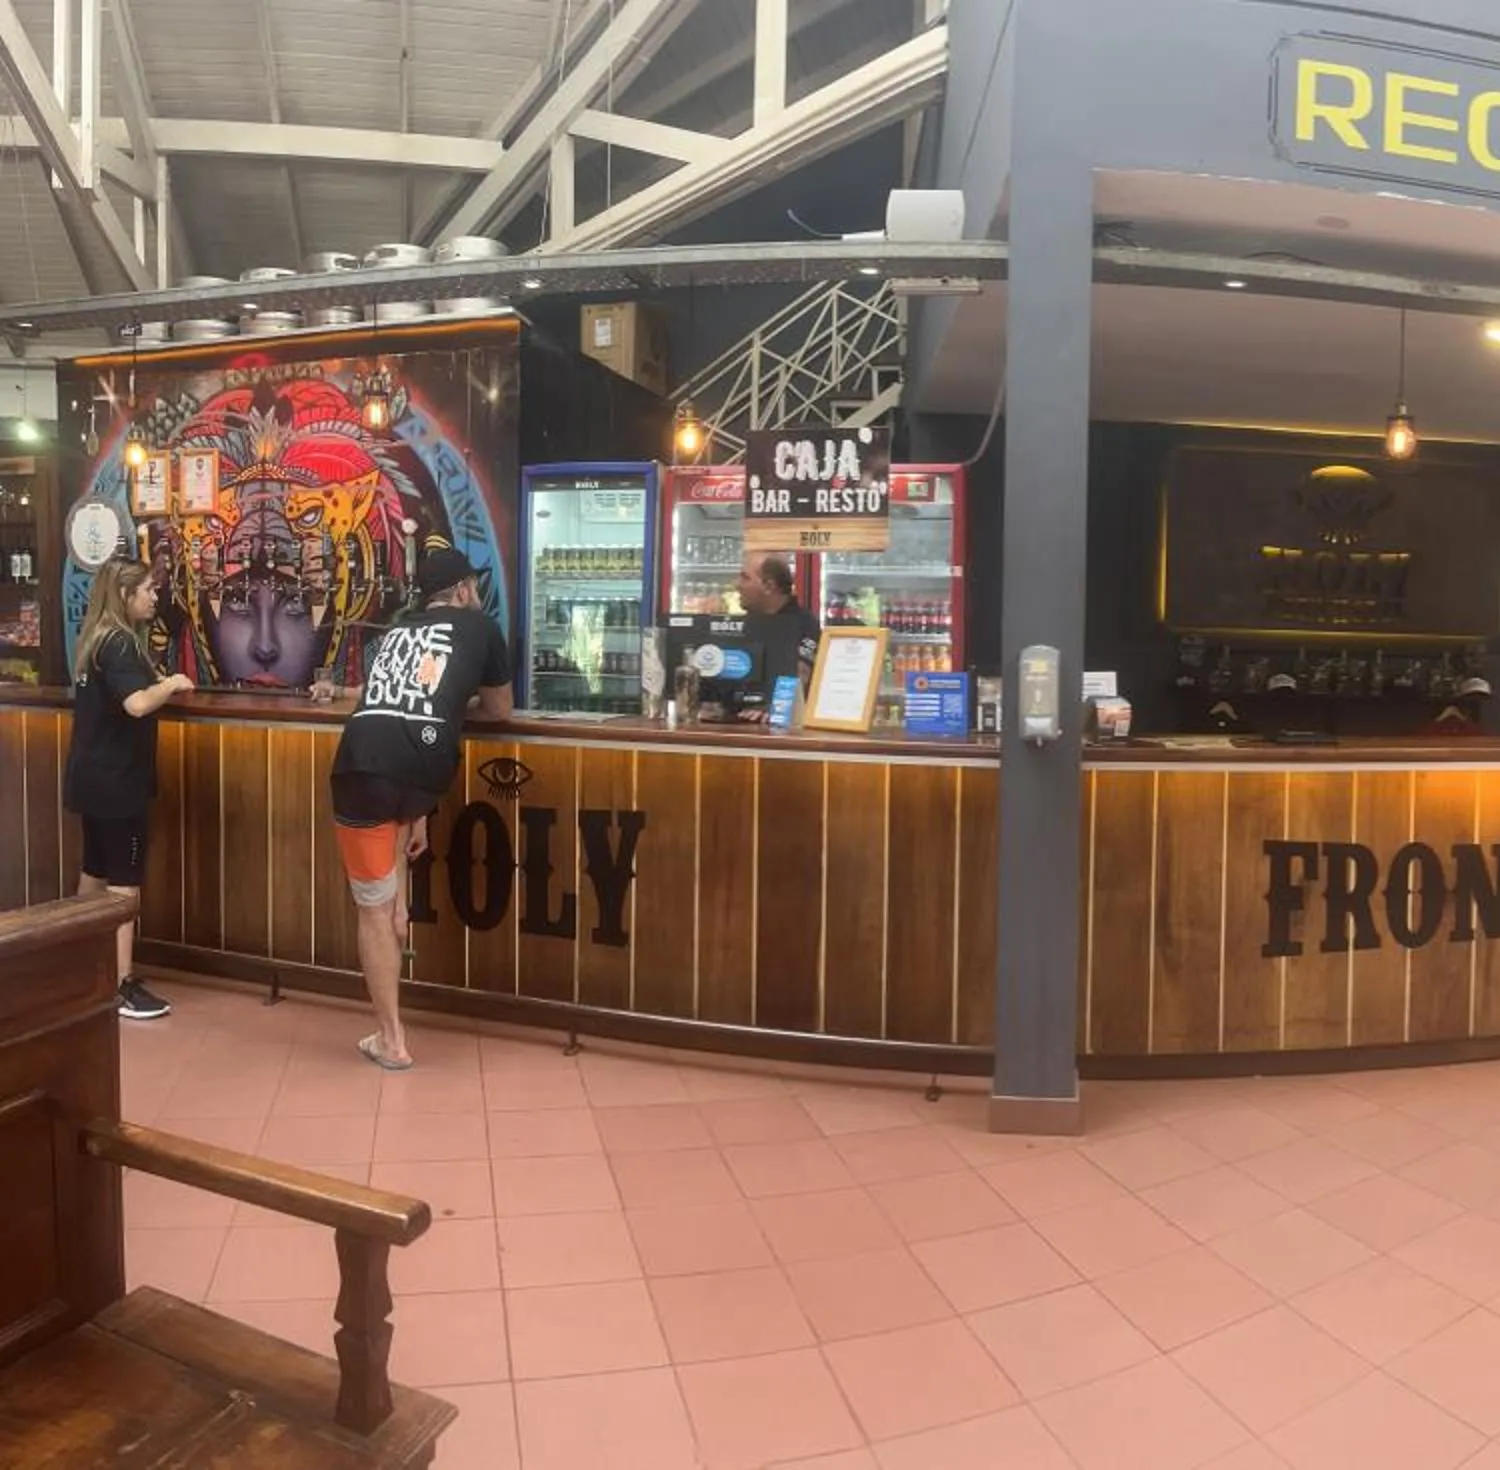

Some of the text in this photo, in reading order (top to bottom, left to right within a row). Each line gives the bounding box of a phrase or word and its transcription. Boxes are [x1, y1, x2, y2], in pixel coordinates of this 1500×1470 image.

[775, 439, 861, 480] CAJA
[751, 489, 791, 513] BAR
[815, 488, 881, 513] RESTO
